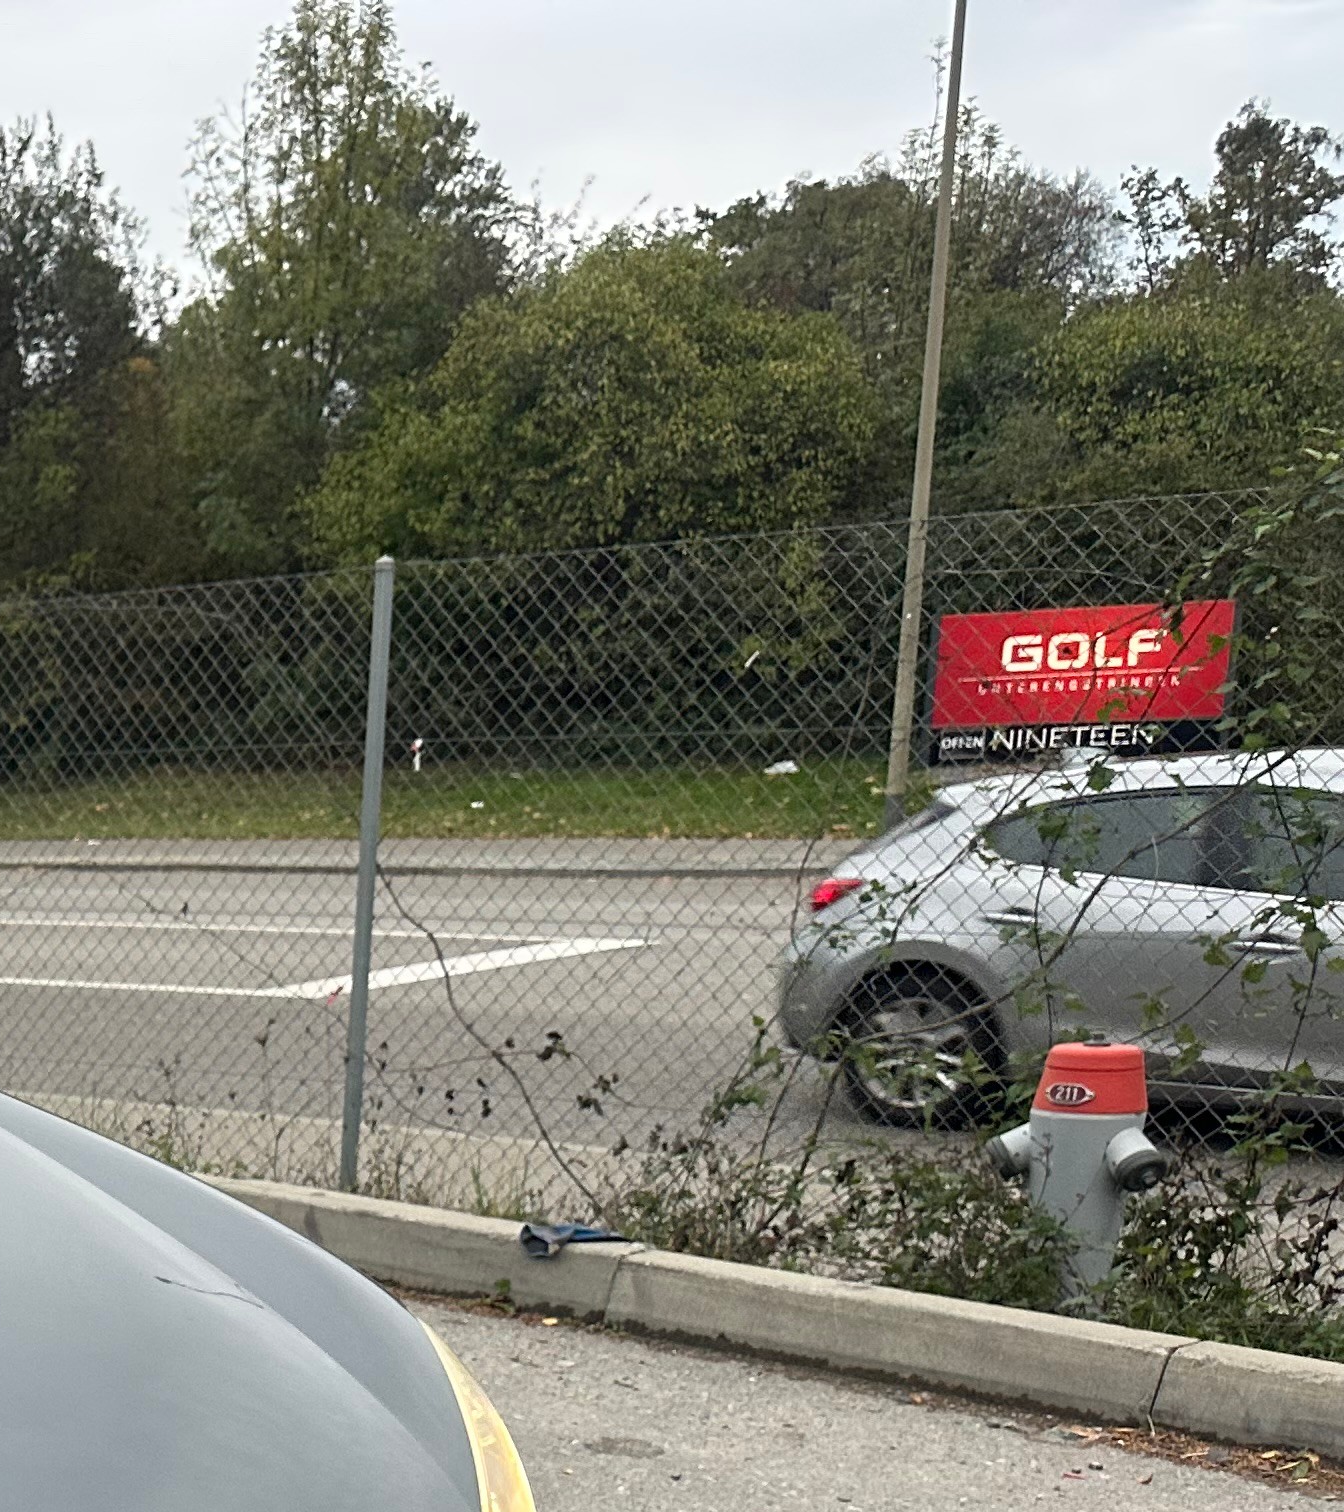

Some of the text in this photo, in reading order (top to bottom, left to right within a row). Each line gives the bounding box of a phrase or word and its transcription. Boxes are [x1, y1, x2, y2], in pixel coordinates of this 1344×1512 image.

[1001, 628, 1169, 672] GOLF
[991, 725, 1154, 752] NINETEEN
[1055, 1085, 1079, 1101] 211
